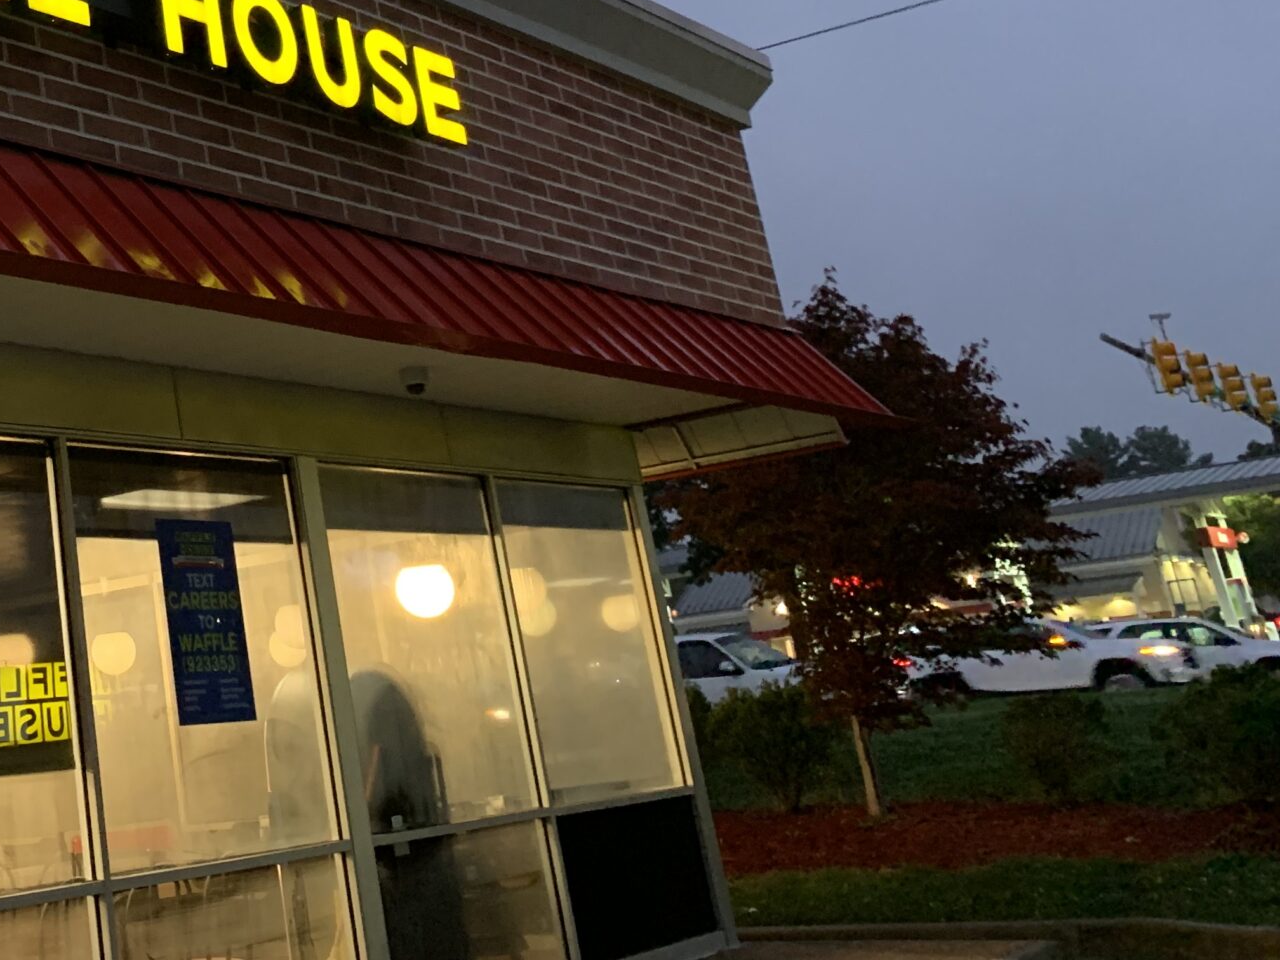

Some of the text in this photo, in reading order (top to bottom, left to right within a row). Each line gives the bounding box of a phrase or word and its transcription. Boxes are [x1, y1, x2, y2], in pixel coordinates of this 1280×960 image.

[186, 573, 215, 588] TEXT
[168, 591, 239, 609] CAREERS
[198, 614, 215, 630] TO
[178, 632, 238, 652] WAFFLE
